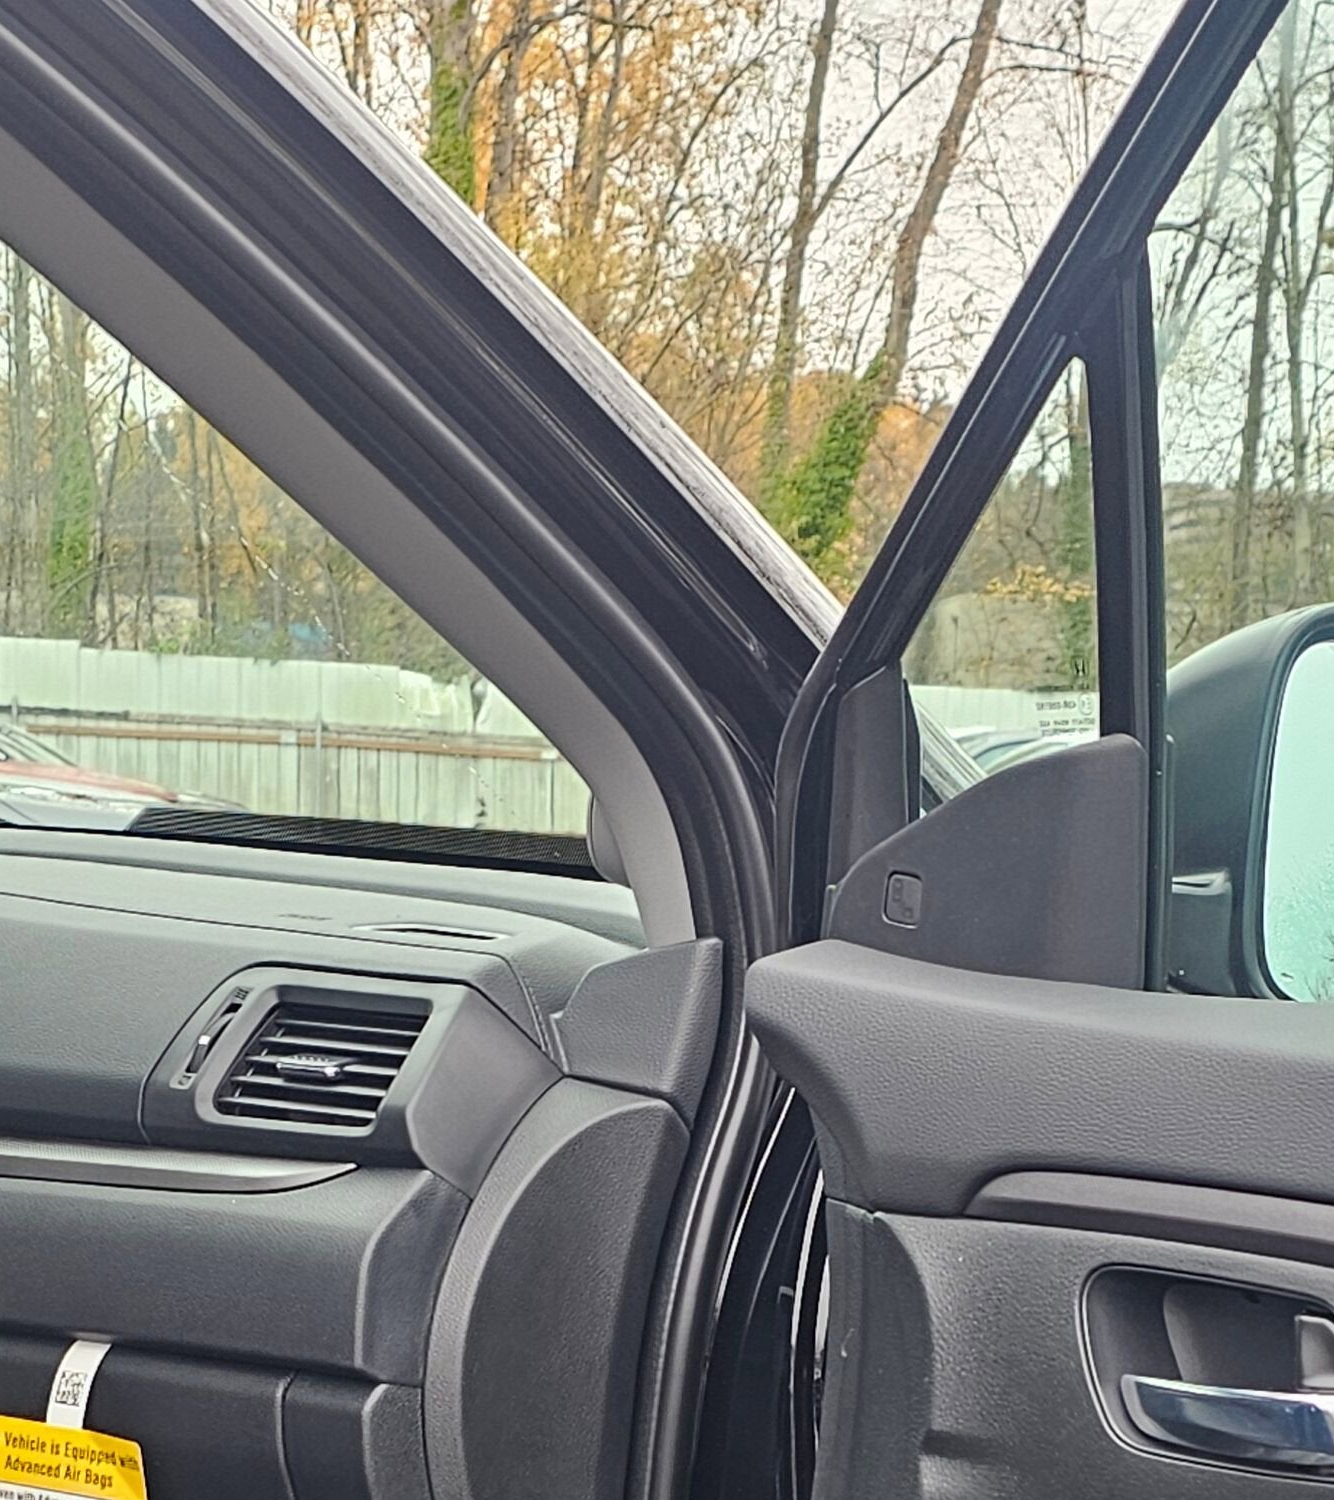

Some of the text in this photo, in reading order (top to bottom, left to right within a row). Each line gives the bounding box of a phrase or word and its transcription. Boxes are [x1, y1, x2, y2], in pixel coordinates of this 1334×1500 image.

[4, 1431, 47, 1454] Vehicle
[50, 1438, 61, 1456] is
[64, 1441, 117, 1467] Equipped
[4, 1454, 114, 1490] Advanced Air Bags
